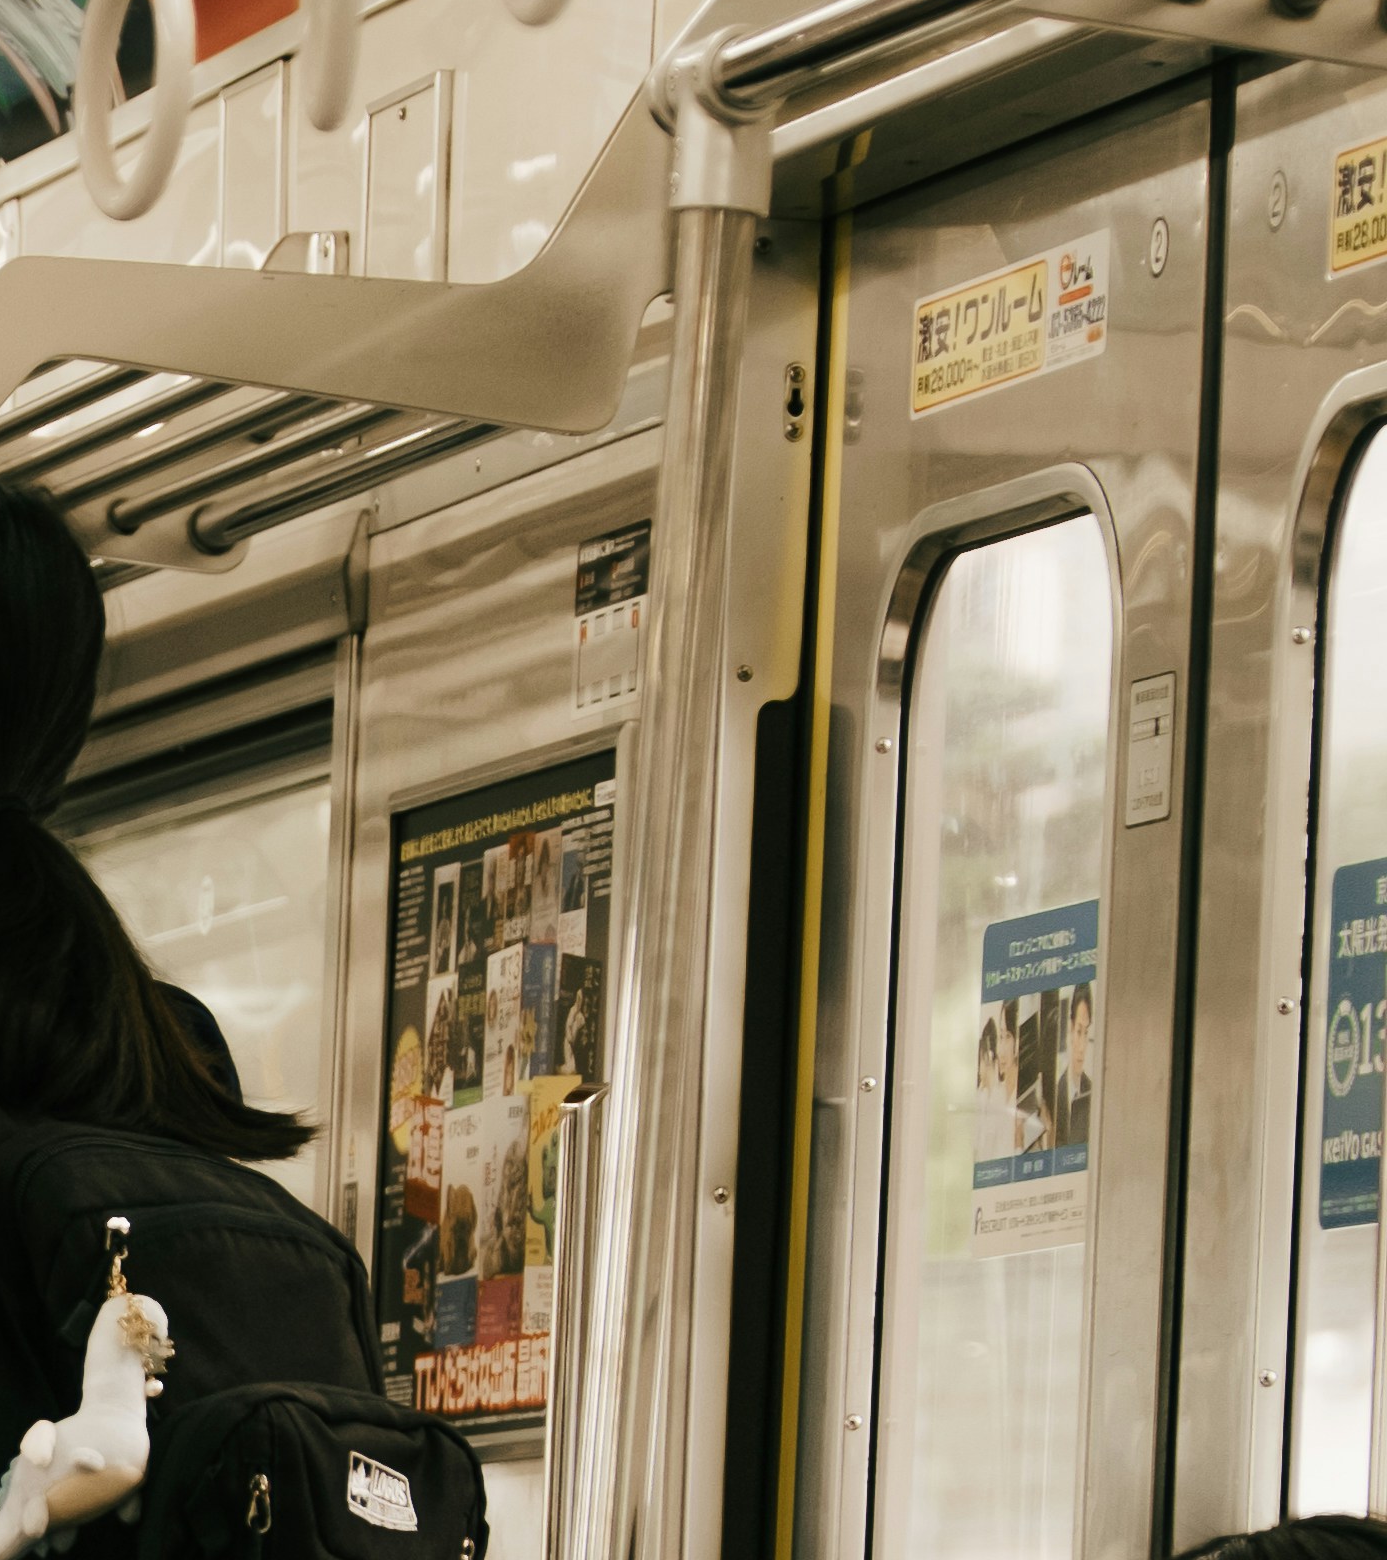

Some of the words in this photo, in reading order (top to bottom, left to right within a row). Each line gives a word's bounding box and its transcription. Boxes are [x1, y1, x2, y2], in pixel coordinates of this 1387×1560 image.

[917, 271, 1044, 364] 激安!ワンルーム
